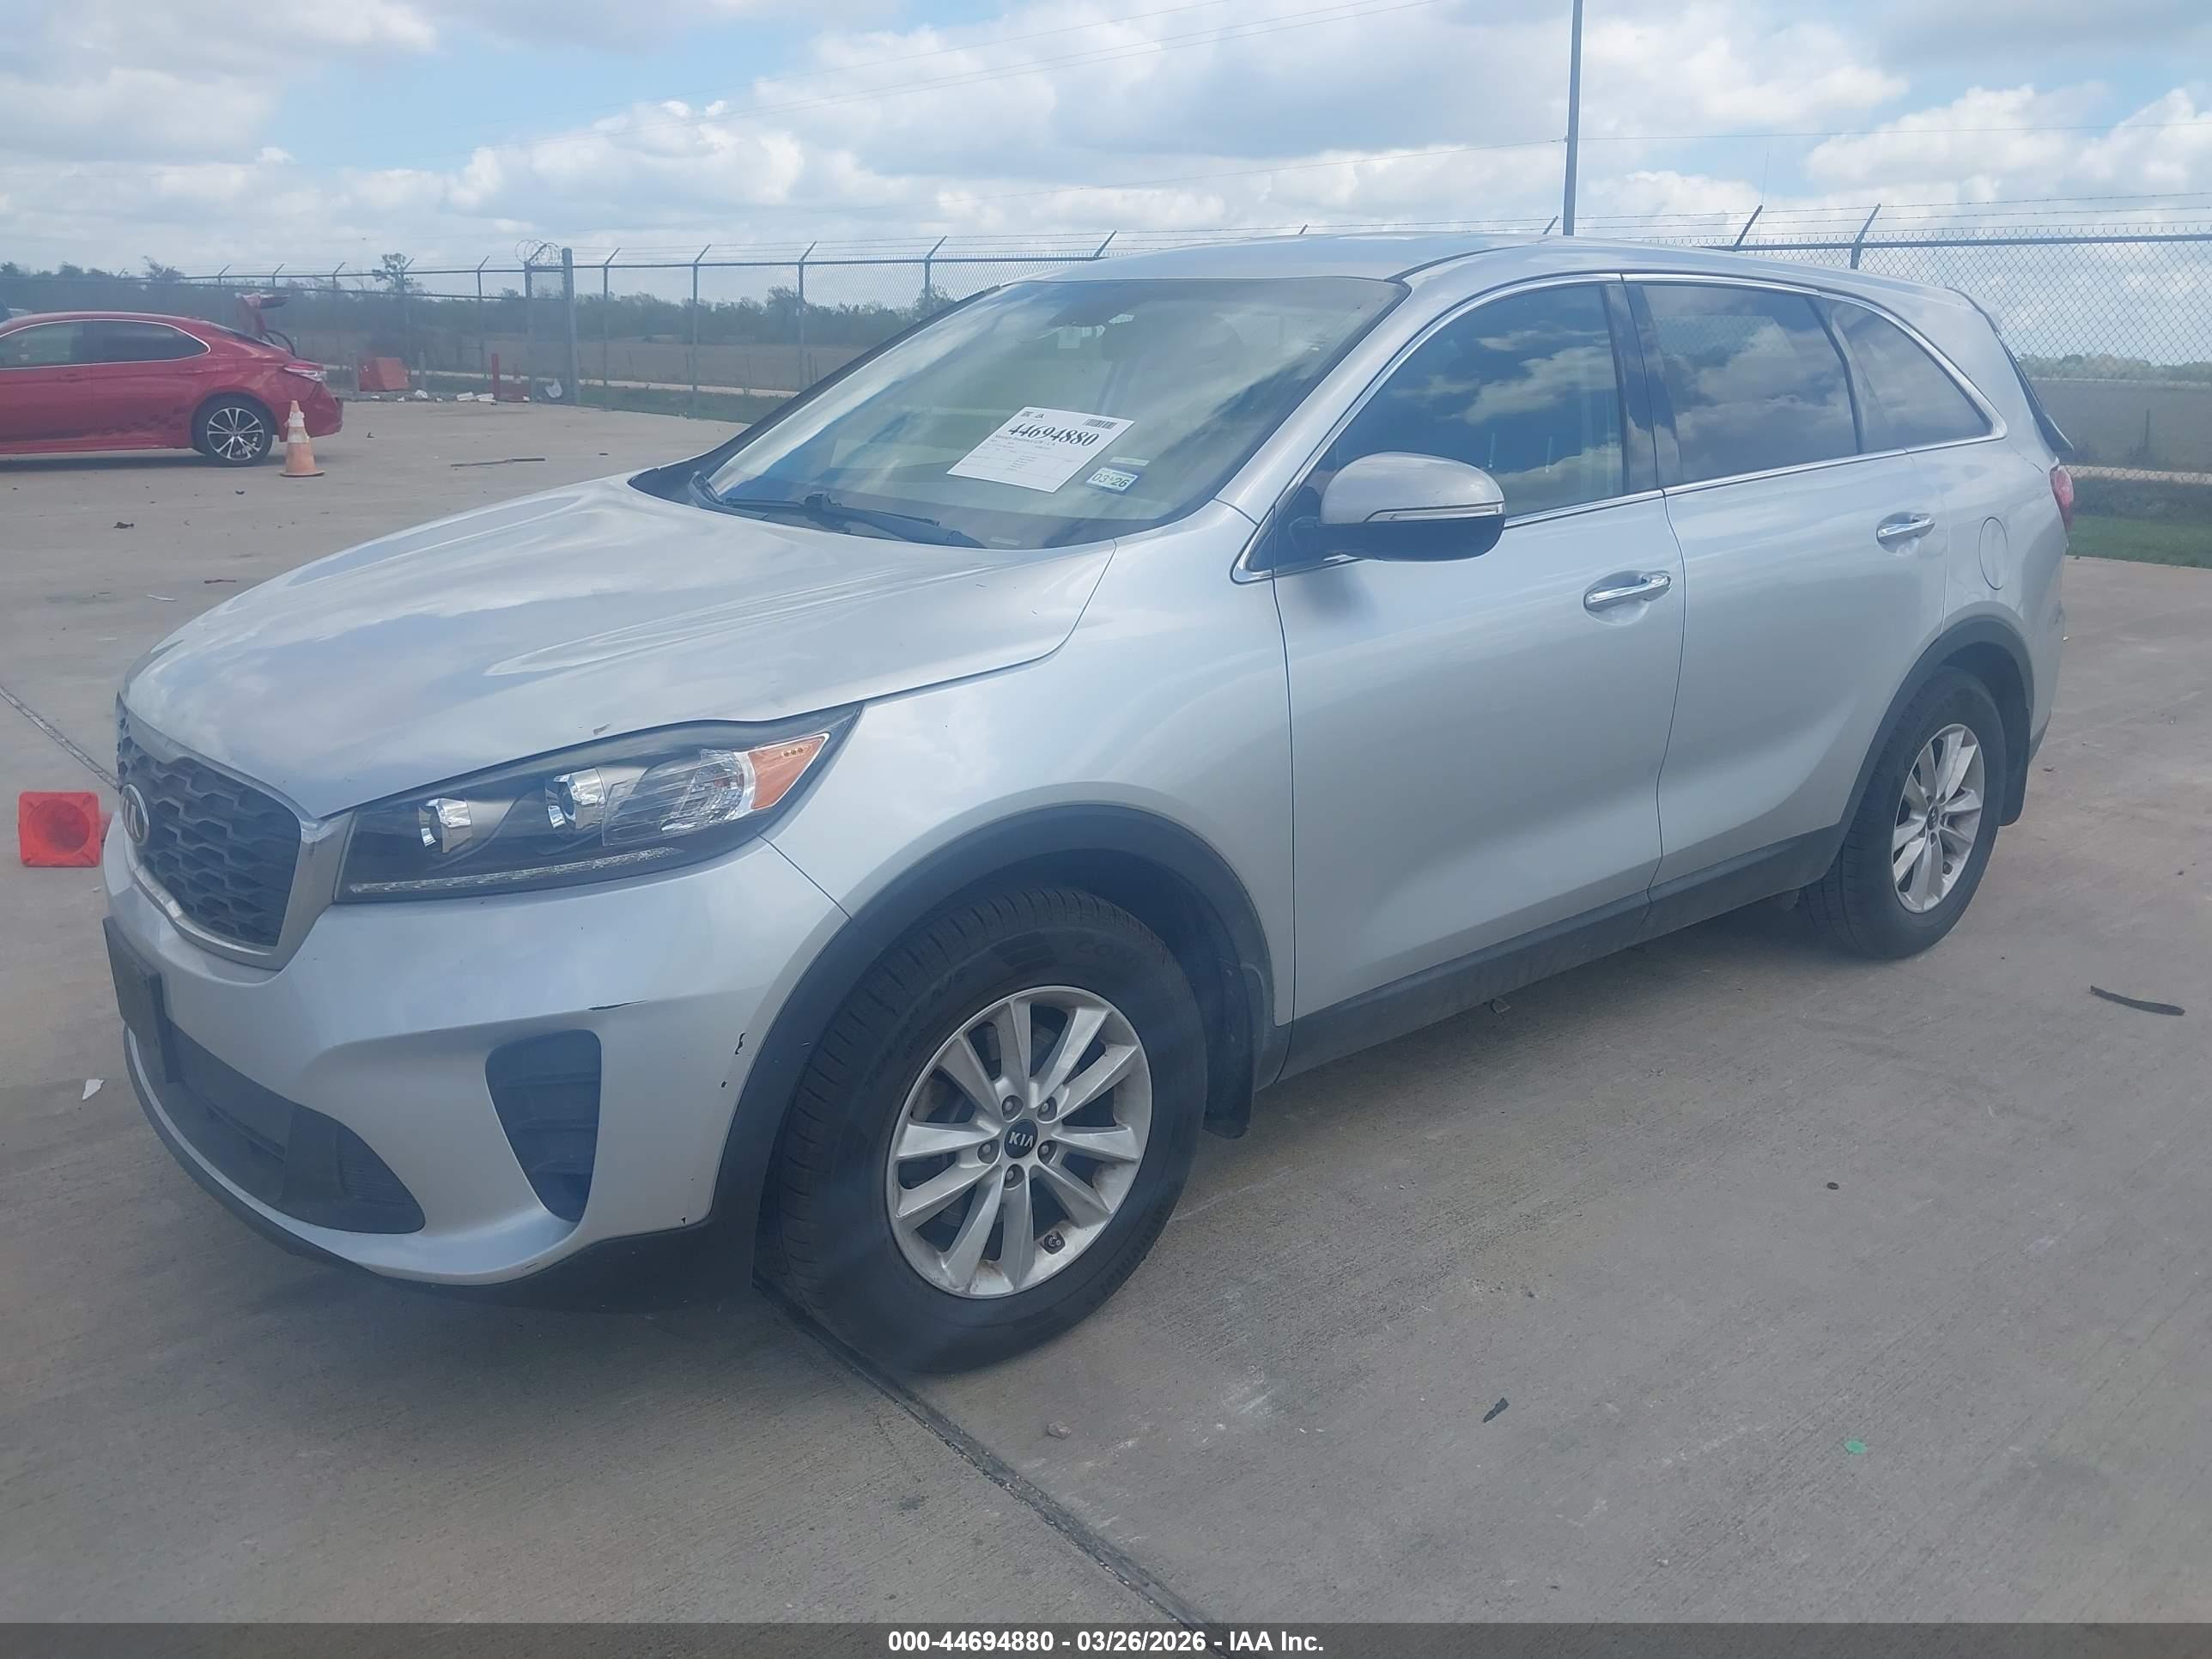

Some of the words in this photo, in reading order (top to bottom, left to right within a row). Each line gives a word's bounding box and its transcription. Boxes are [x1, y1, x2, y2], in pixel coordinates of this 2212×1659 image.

[1008, 423, 1100, 447] 44694880
[1110, 477, 1129, 488] 26
[1008, 1131, 1034, 1148] KIA
